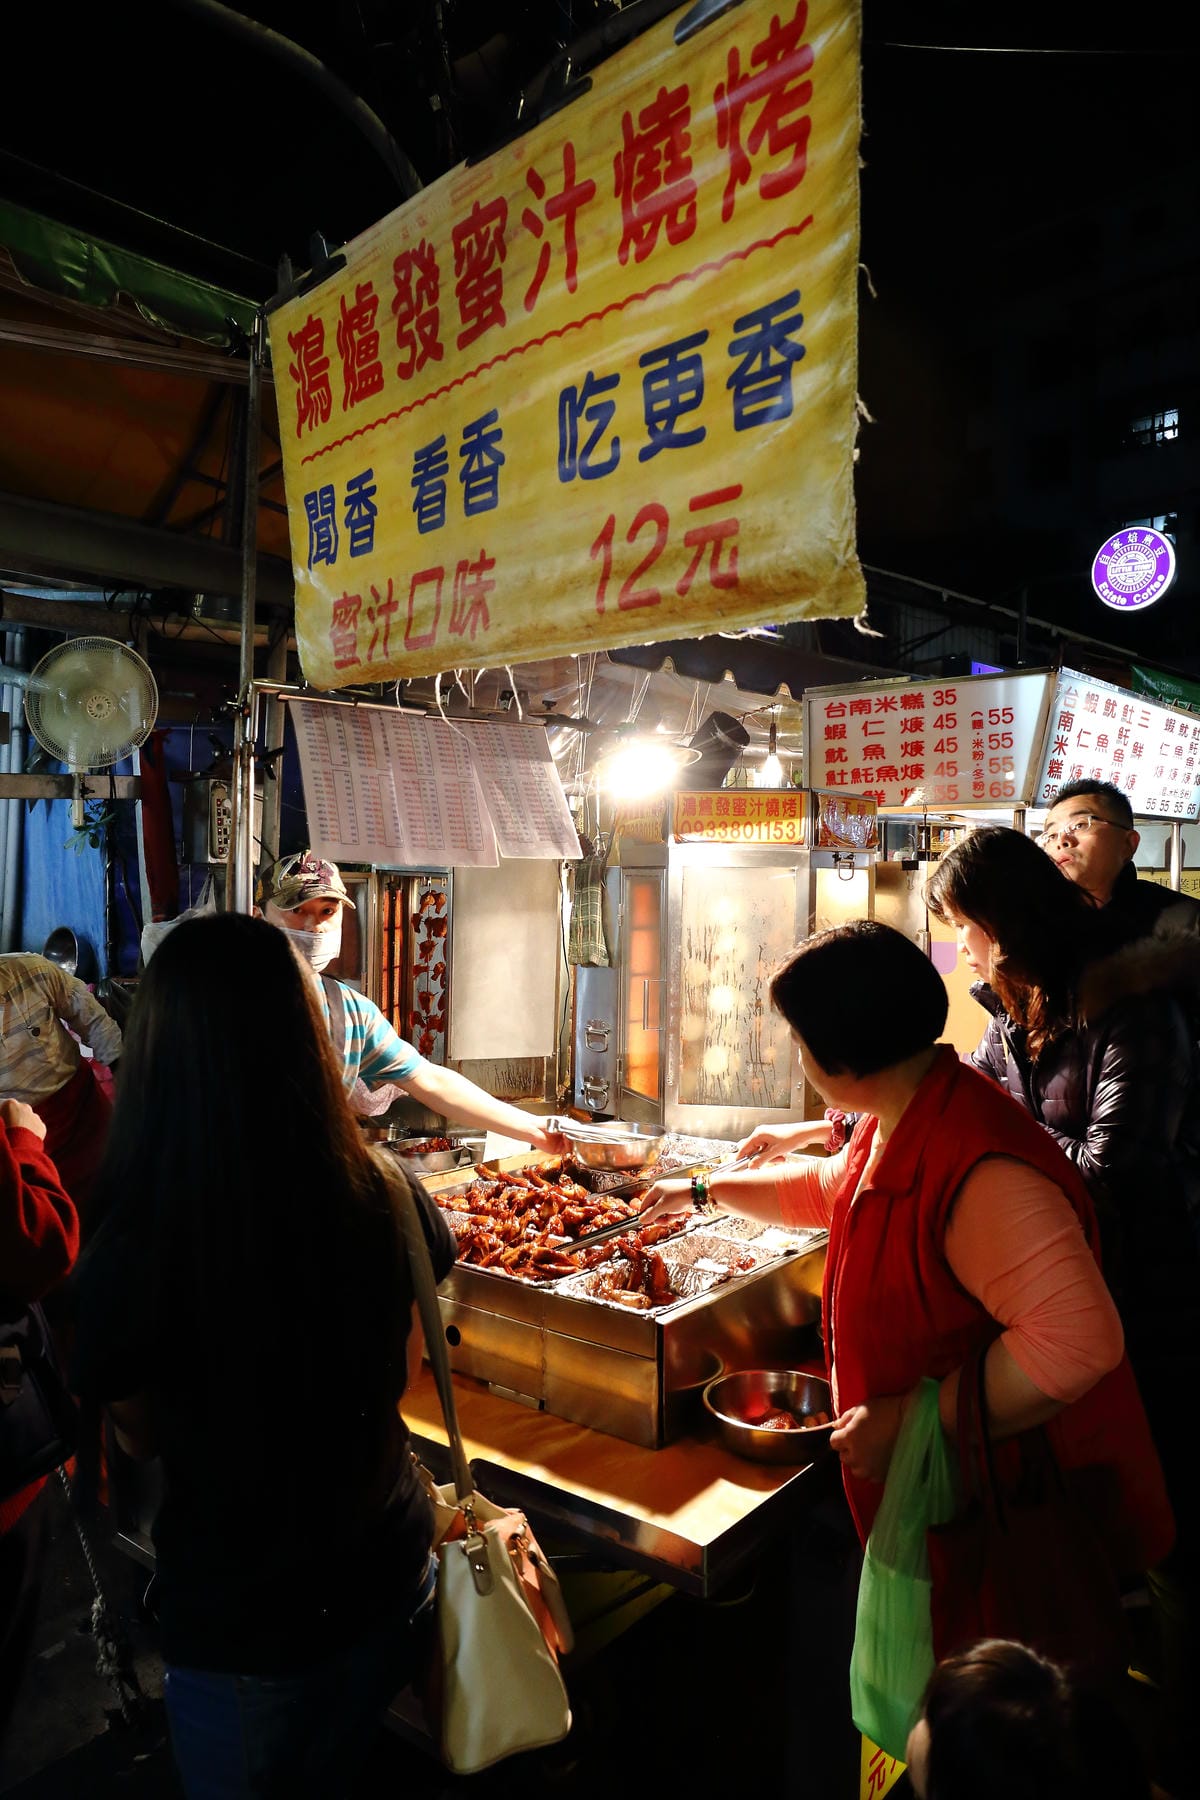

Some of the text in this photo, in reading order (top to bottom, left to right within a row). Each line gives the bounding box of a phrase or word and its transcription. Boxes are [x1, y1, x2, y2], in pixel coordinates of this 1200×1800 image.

[305, 290, 805, 570] 聞香 看香 吃更香
[330, 484, 743, 670] 蜜汁口味 12元
[824, 688, 957, 719] 台南米糕 35
[932, 712, 958, 730] 45
[988, 706, 1014, 726] 55
[933, 736, 959, 754] 45
[988, 732, 1014, 751] 55
[934, 761, 959, 778] 45
[988, 756, 1015, 774] 55
[989, 780, 1015, 798] 65
[1159, 799, 1171, 812] 55
[1173, 801, 1184, 814] 55
[1186, 803, 1197, 815] 65
[681, 820, 796, 840] 0933801153
